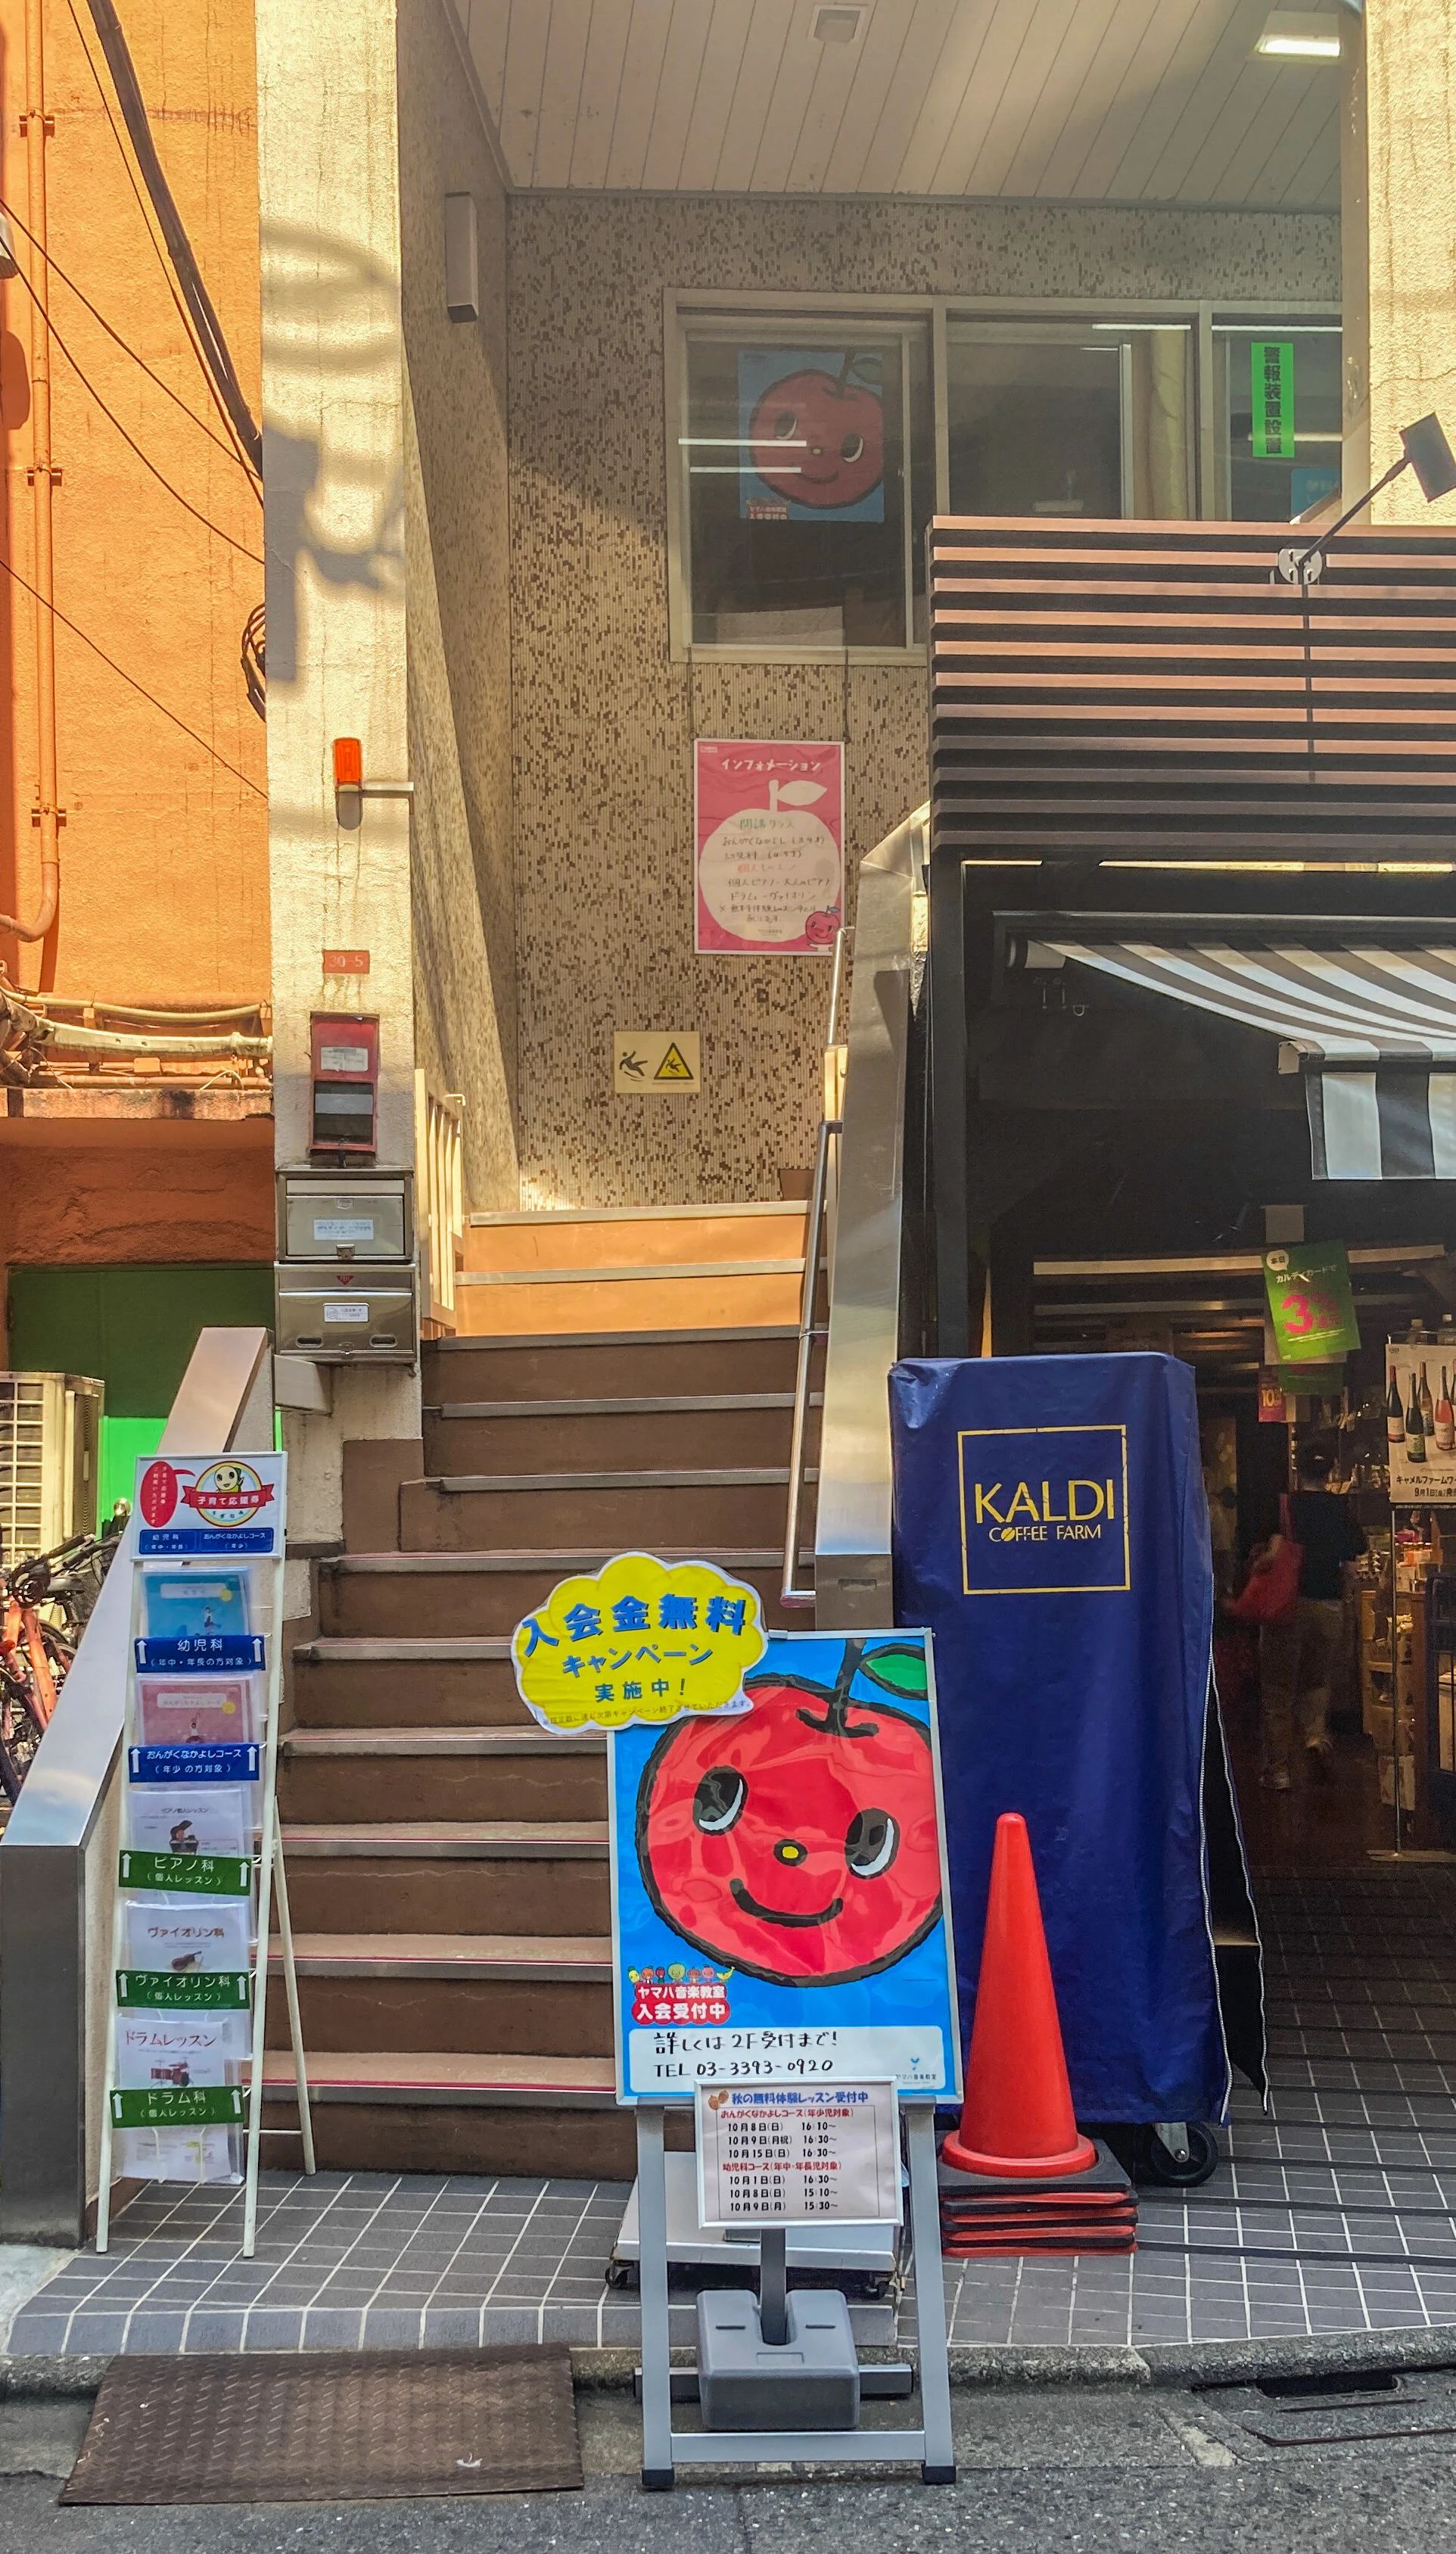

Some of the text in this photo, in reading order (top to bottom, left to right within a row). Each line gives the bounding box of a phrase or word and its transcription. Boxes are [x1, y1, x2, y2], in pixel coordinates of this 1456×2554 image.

[721, 758, 821, 771] インフォメーション
[328, 955, 363, 968] 30-5
[197, 1495, 260, 1506] 子育て応援券
[974, 1478, 1115, 1525] KALDI
[988, 1524, 1102, 1543] COFFEE FARM
[521, 1593, 748, 1657] 入会金無料
[177, 1638, 223, 1652] 幼児科
[562, 1643, 713, 1678] キャンペーン
[594, 1677, 686, 1702] 実施中!
[147, 1749, 242, 1759] おんがくなかよしコース
[154, 1856, 215, 1872] ピアノ科
[148, 1926, 225, 1938] ヴァイオリン科
[135, 1974, 231, 1987] ヴァイオリン科
[637, 1985, 725, 1999] ヤマハ音楽教室
[636, 2002, 726, 2020] 入会受付中
[126, 2030, 217, 2047] ドラムレッスン
[654, 2058, 833, 2077] TEL 03-3393-0920
[148, 2090, 207, 2105] ドラム科
[732, 2091, 870, 2105] 秋の無料体験レッスン受付中
